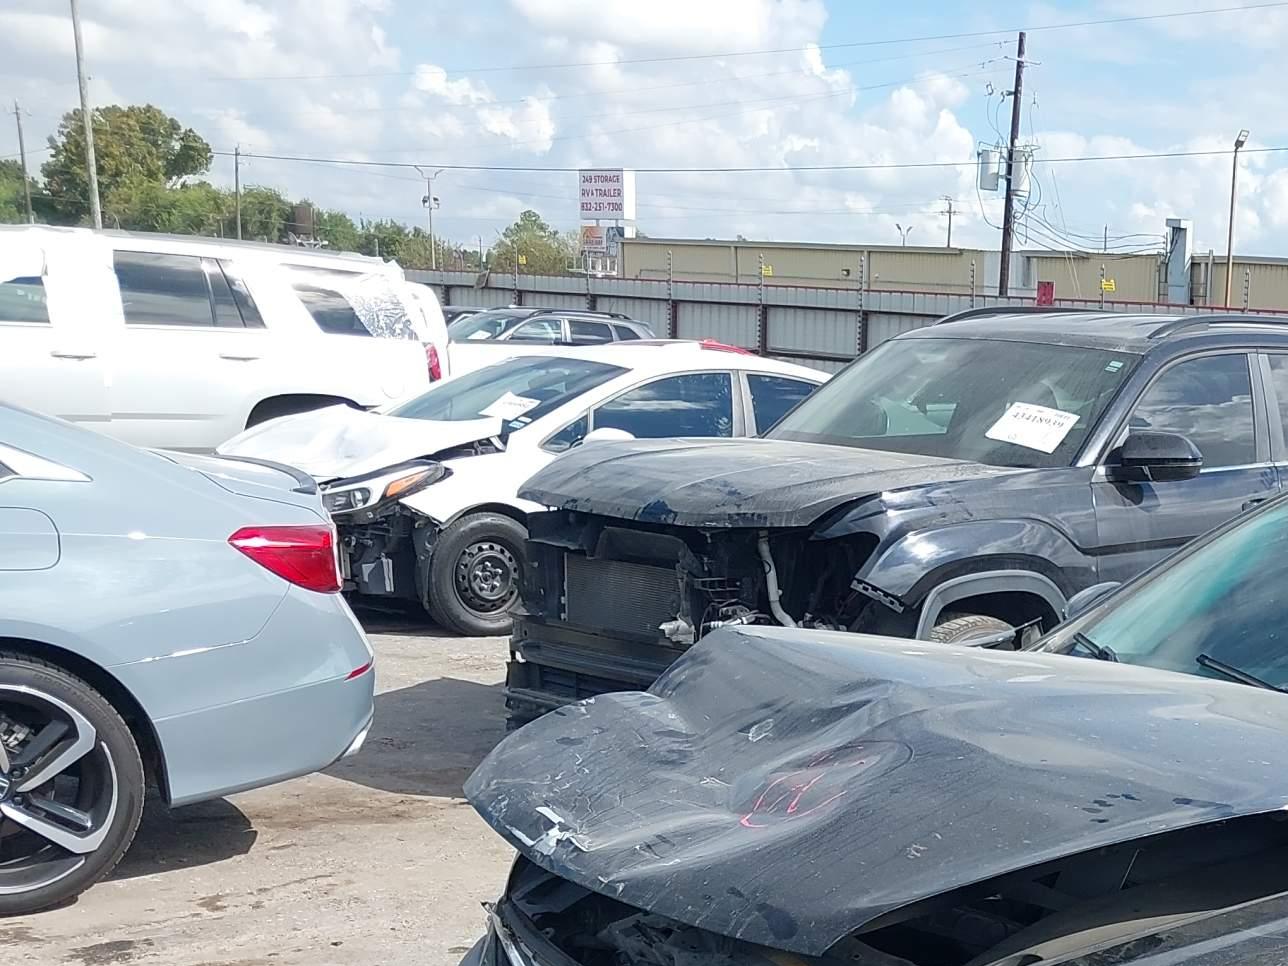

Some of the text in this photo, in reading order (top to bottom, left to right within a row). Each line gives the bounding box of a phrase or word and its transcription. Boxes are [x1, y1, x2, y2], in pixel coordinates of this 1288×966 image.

[593, 175, 620, 184] STORAGE
[581, 188, 590, 198] RV
[595, 188, 622, 198] TRAILER
